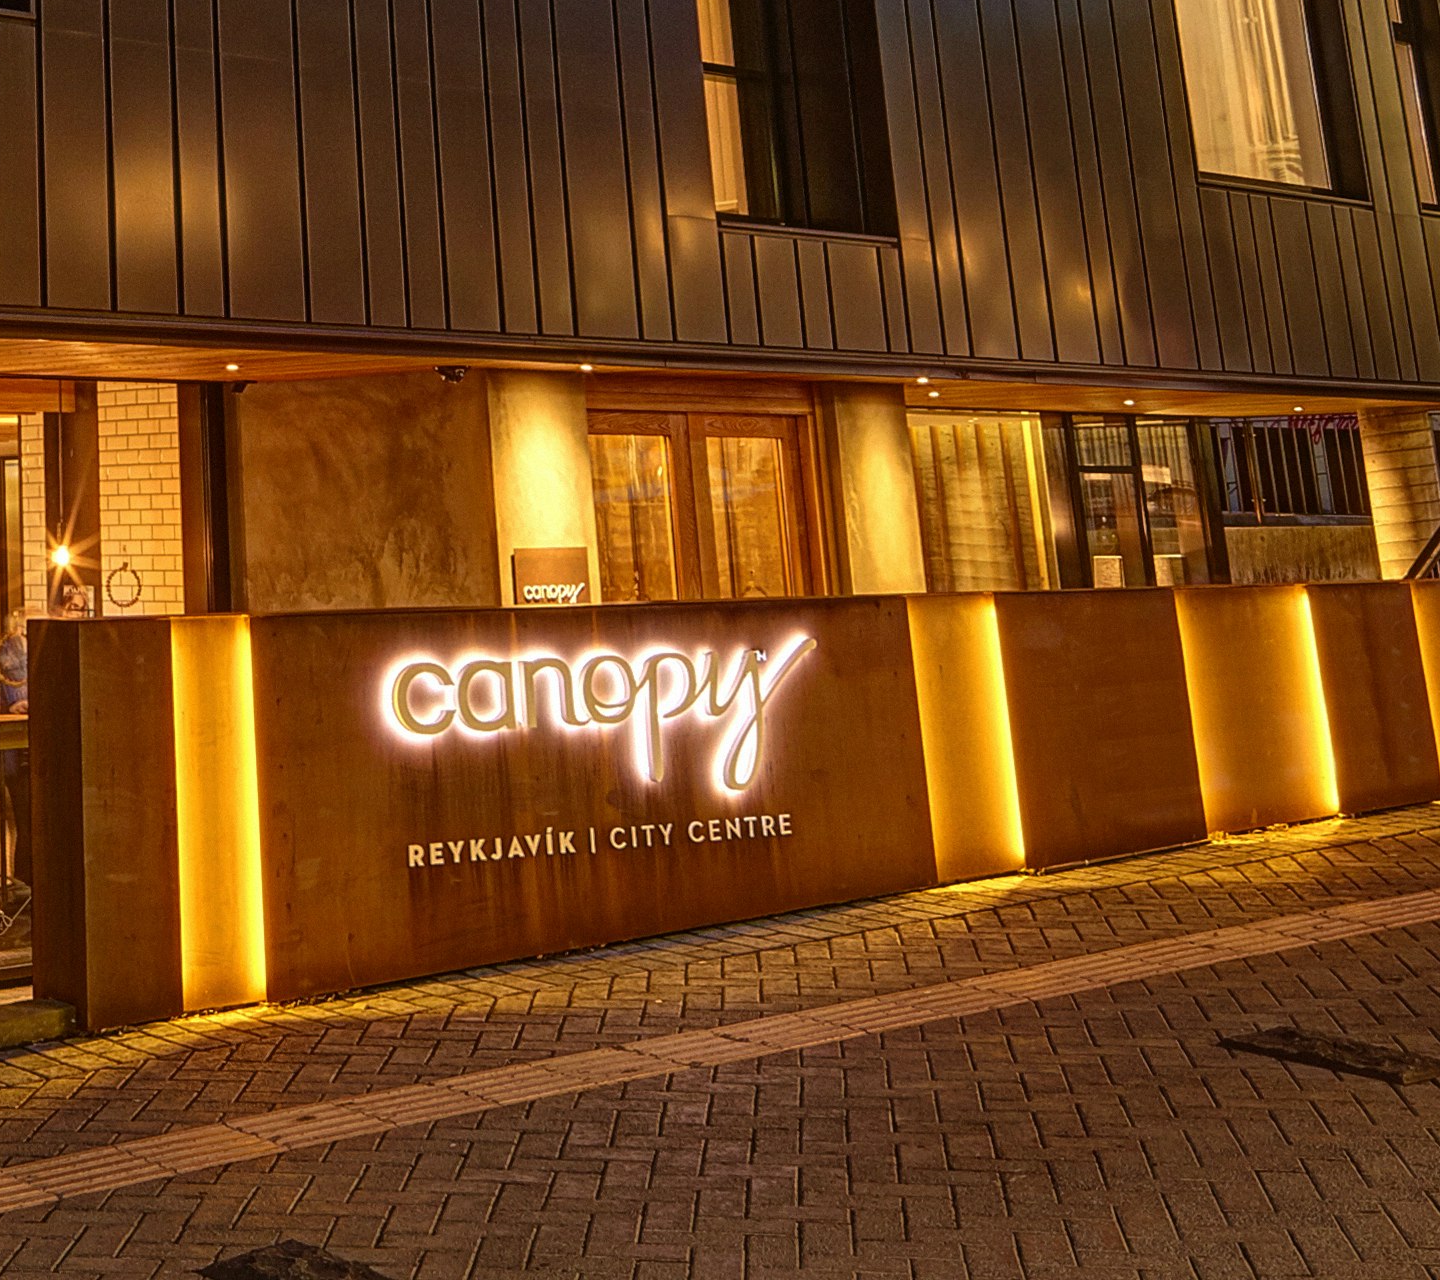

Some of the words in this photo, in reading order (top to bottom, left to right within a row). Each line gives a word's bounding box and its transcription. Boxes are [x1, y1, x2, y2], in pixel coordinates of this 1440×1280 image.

[522, 582, 586, 604] canopy
[391, 637, 818, 792] canopy
[407, 826, 577, 869] REYKJAVÍK
[609, 823, 674, 851] CITY
[687, 813, 794, 842] CENTRE
